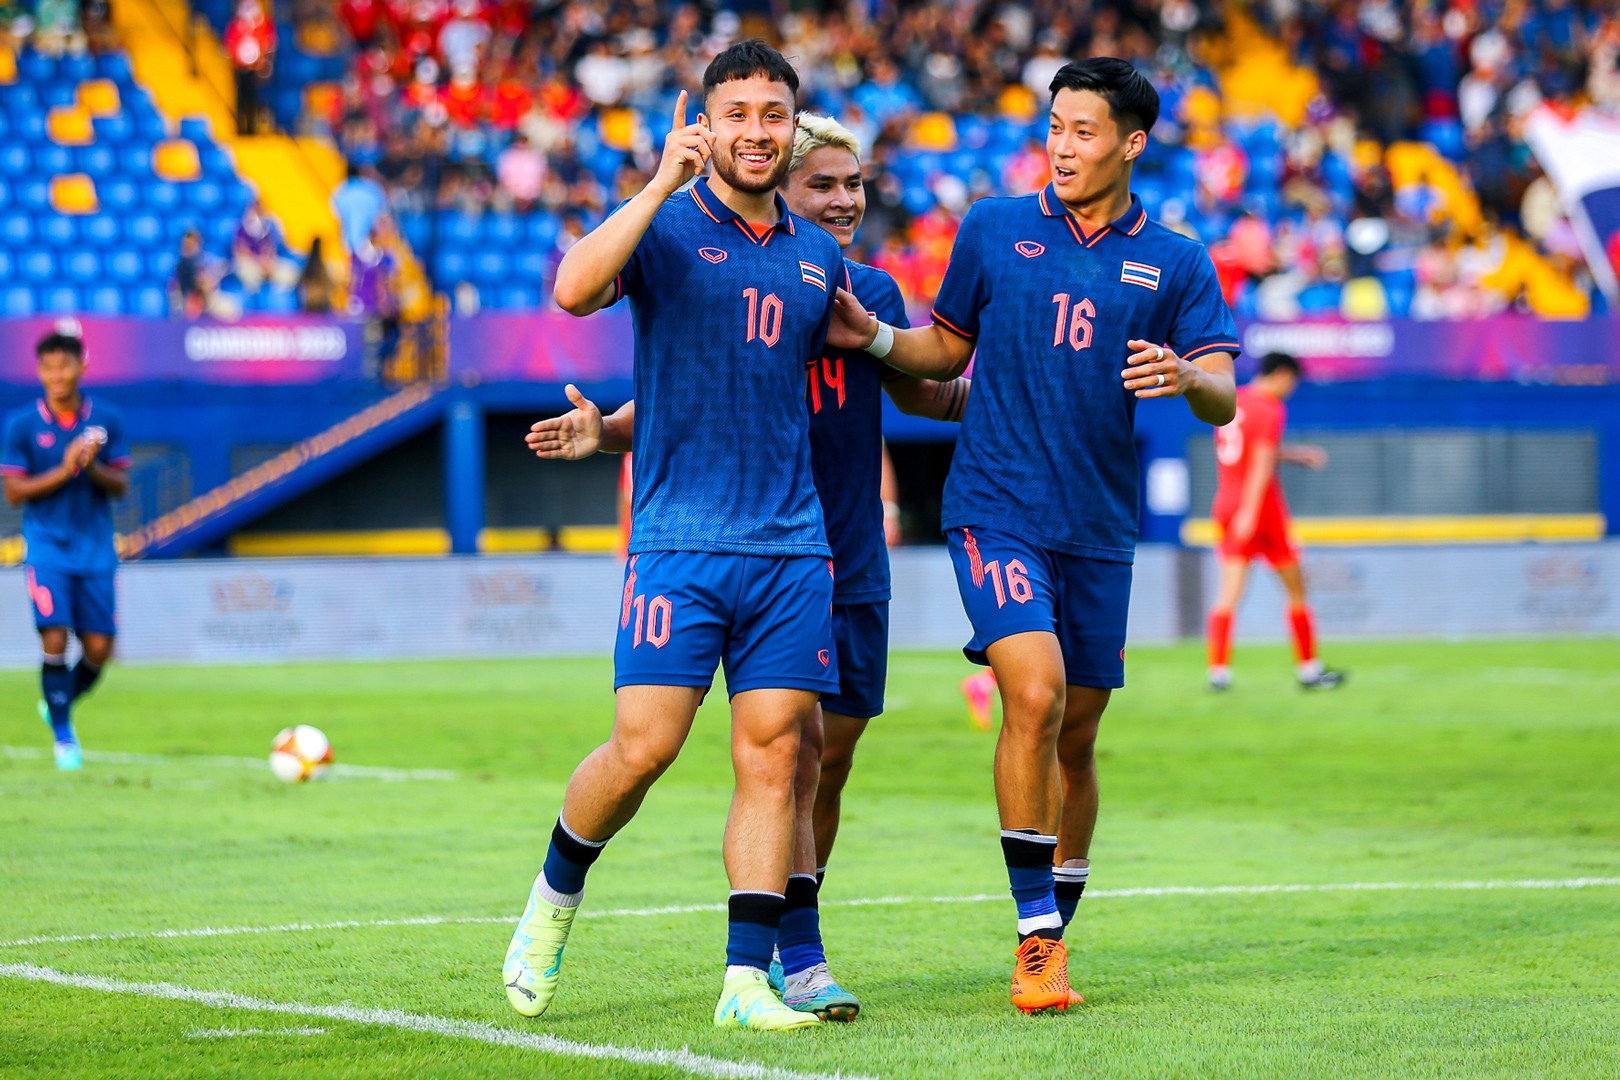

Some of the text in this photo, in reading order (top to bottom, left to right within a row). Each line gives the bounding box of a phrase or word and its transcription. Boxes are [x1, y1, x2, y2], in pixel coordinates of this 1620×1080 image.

[743, 287, 783, 348] 10
[1052, 293, 1096, 351] 16
[806, 357, 846, 414] 14
[984, 558, 1034, 609] 16
[633, 594, 673, 650] 10
